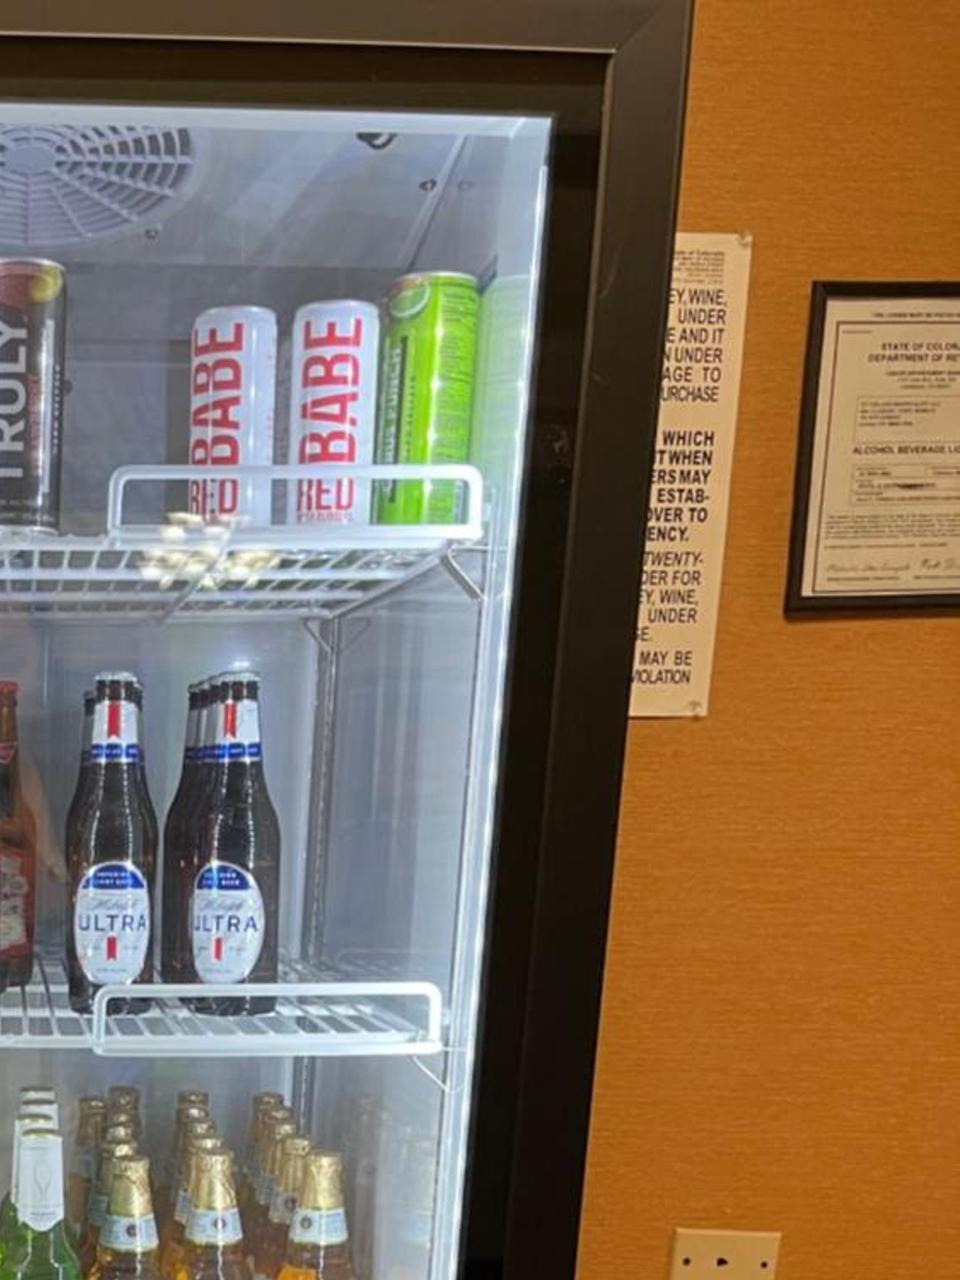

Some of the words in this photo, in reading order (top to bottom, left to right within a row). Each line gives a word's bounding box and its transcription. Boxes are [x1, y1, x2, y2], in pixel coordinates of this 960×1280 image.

[688, 288, 727, 307] WINE,
[677, 308, 726, 325] UNDER
[678, 328, 709, 344] AND
[712, 328, 725, 345] IT
[674, 348, 723, 364] UNDER
[702, 367, 722, 384] TO
[298, 317, 363, 466] BABE
[661, 385, 719, 402] URCHASE
[662, 430, 715, 447] WHICH
[668, 449, 713, 466] WHEN
[679, 469, 712, 485] MAY
[657, 488, 710, 504] ESTAB-
[688, 507, 709, 523] TO
[647, 526, 689, 542] ENCY.
[671, 570, 702, 586] FOR
[659, 589, 700, 606] WINE,
[648, 608, 697, 624] UNDER
[639, 650, 669, 666] MAY
[674, 650, 693, 666] BE
[78, 914, 146, 932] ULTRA
